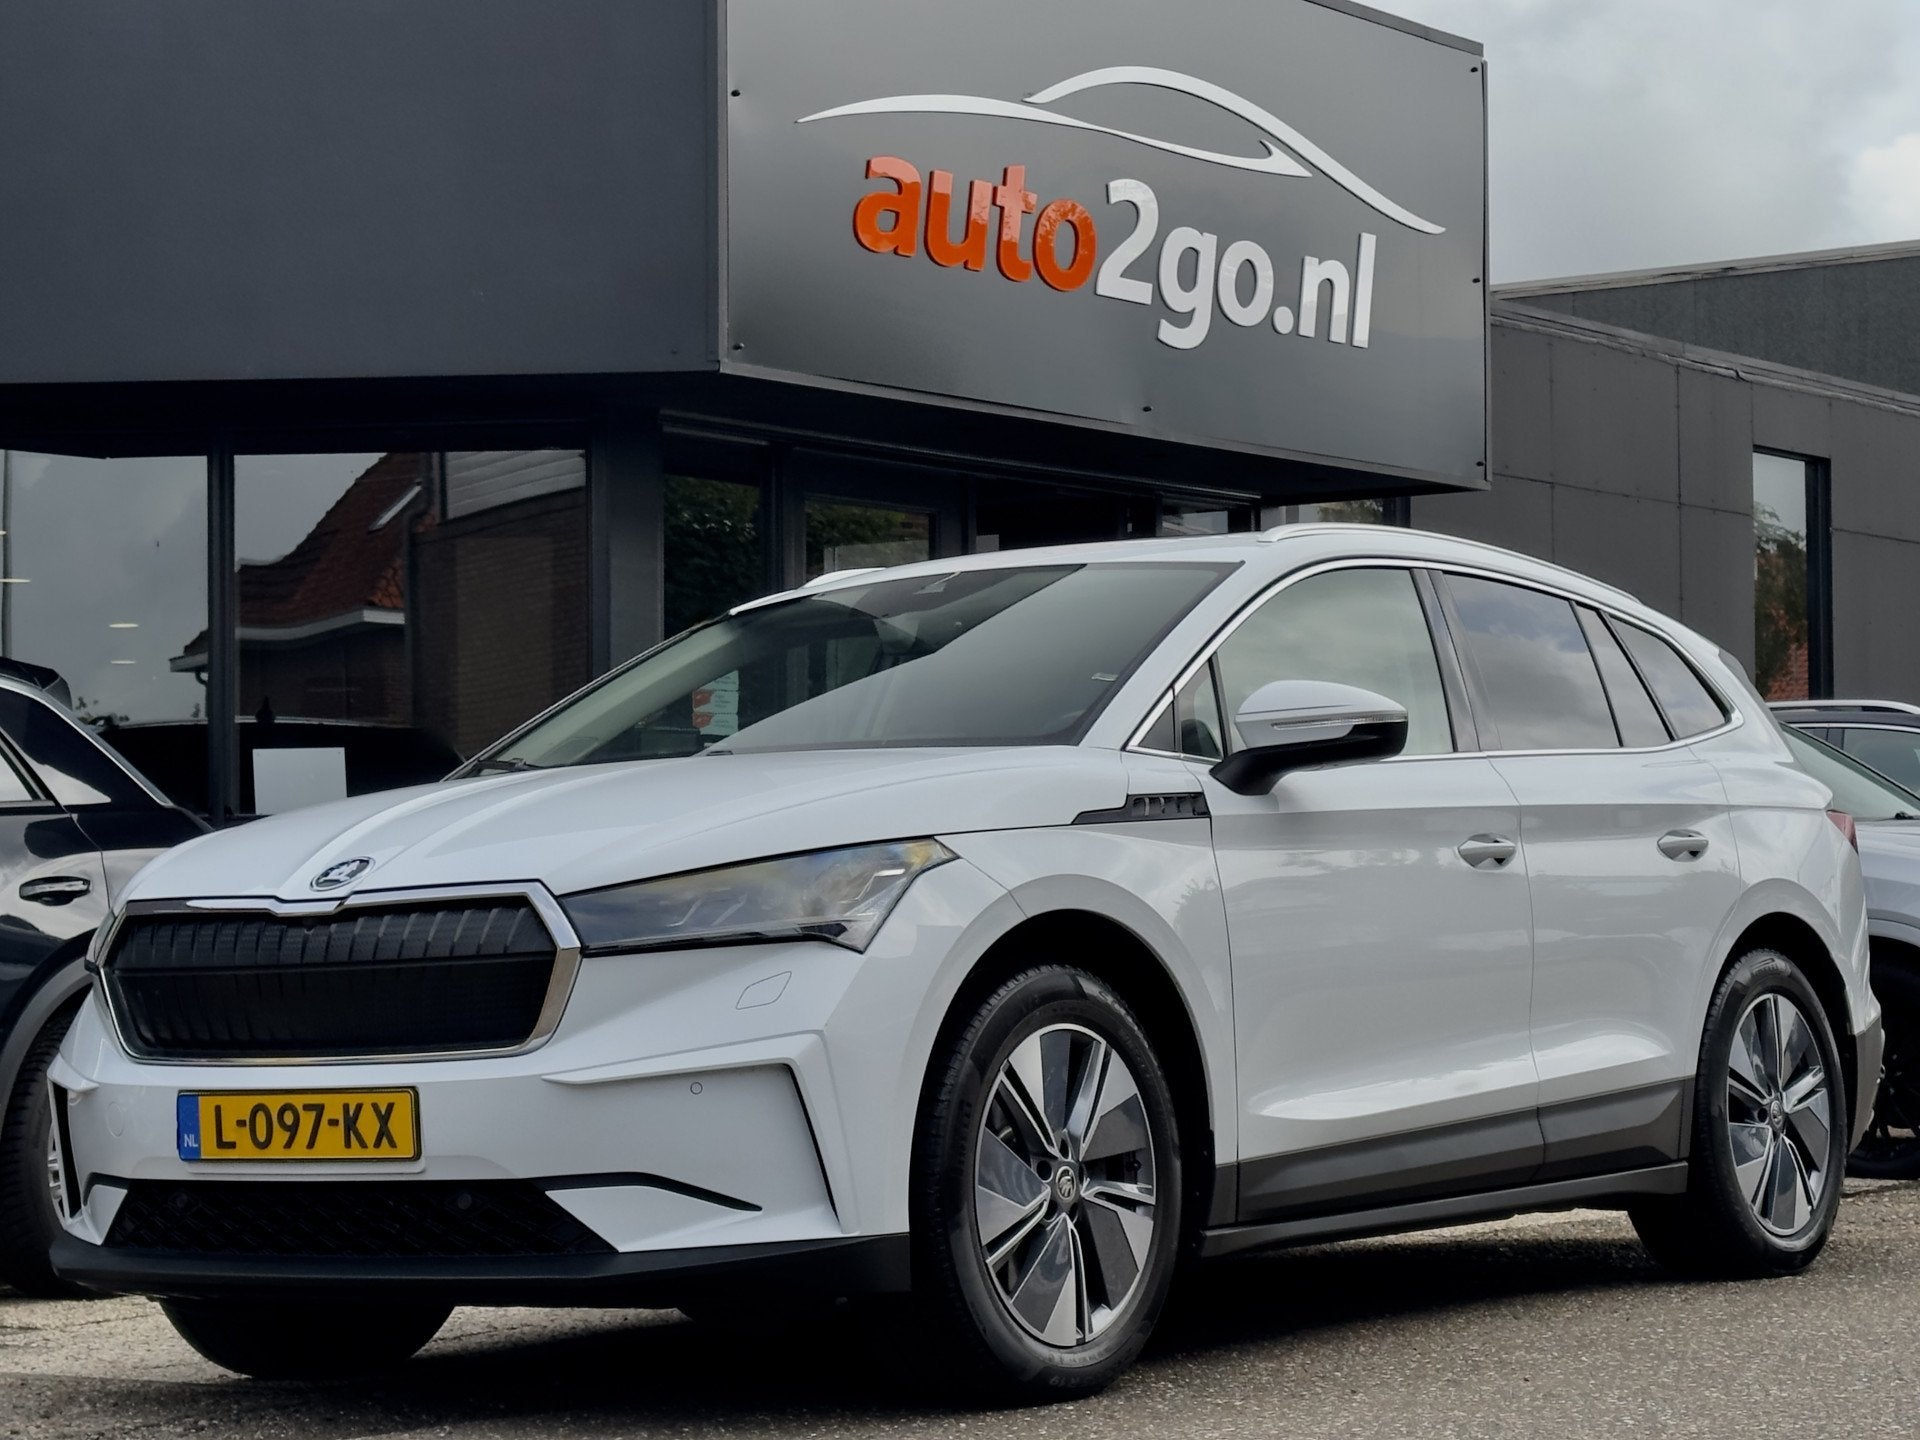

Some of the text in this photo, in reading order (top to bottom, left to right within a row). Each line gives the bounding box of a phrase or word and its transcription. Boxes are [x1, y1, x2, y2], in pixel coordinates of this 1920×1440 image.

[853, 155, 1377, 350] auto2go.nl
[183, 1133, 199, 1148] NL
[214, 1102, 398, 1150] L-097-KX
